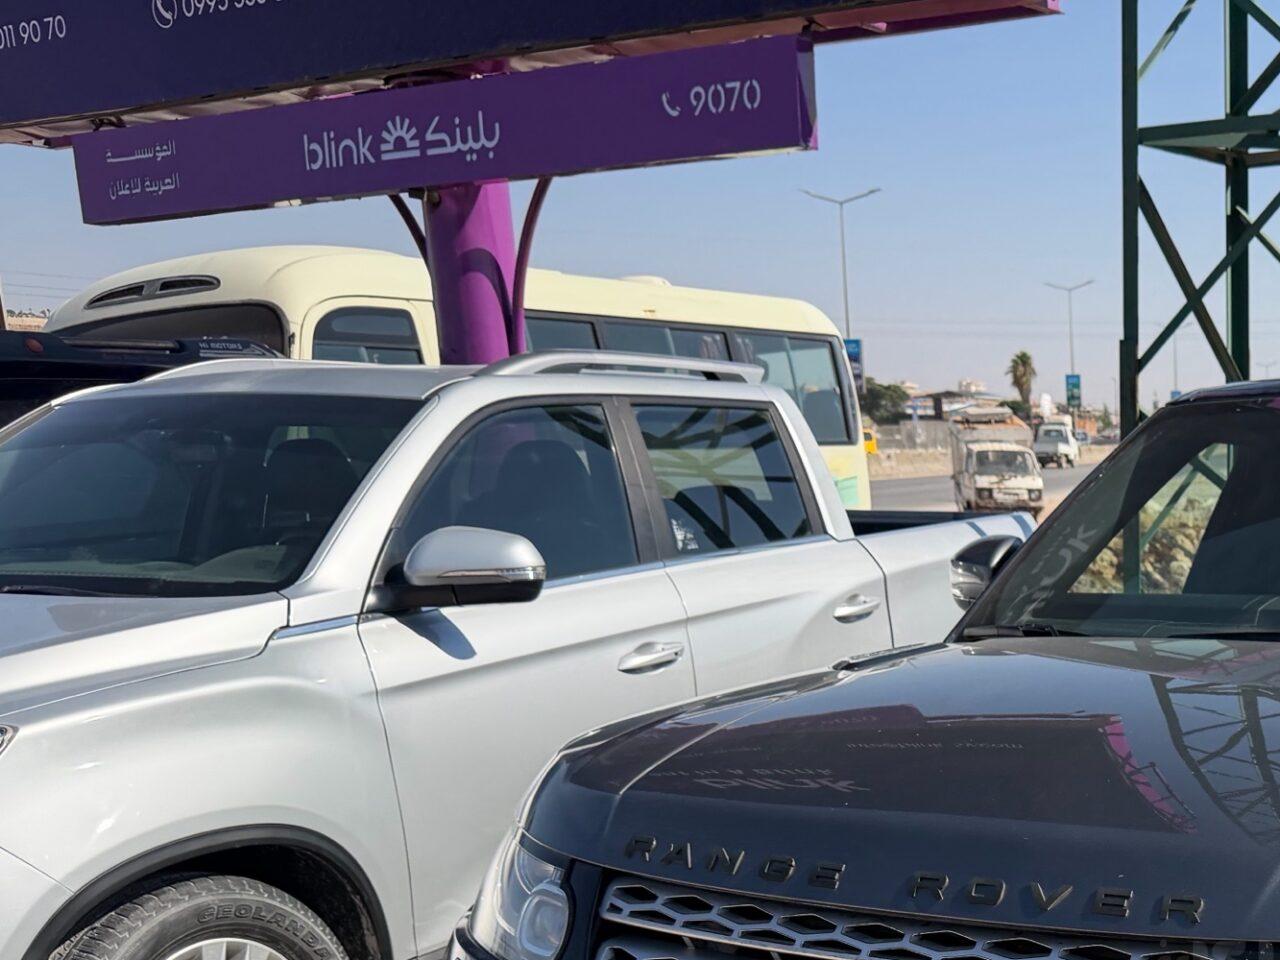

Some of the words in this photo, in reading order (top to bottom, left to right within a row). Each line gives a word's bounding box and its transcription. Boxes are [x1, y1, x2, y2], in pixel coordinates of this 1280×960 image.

[19, 21, 41, 45] 90
[43, 15, 66, 40] 70
[690, 79, 761, 116] 9070
[303, 127, 376, 170] blink
[425, 110, 500, 162] بلينك
[144, 172, 180, 196] العربية
[625, 836, 847, 890] RANGE
[912, 872, 1205, 924] ROVER
